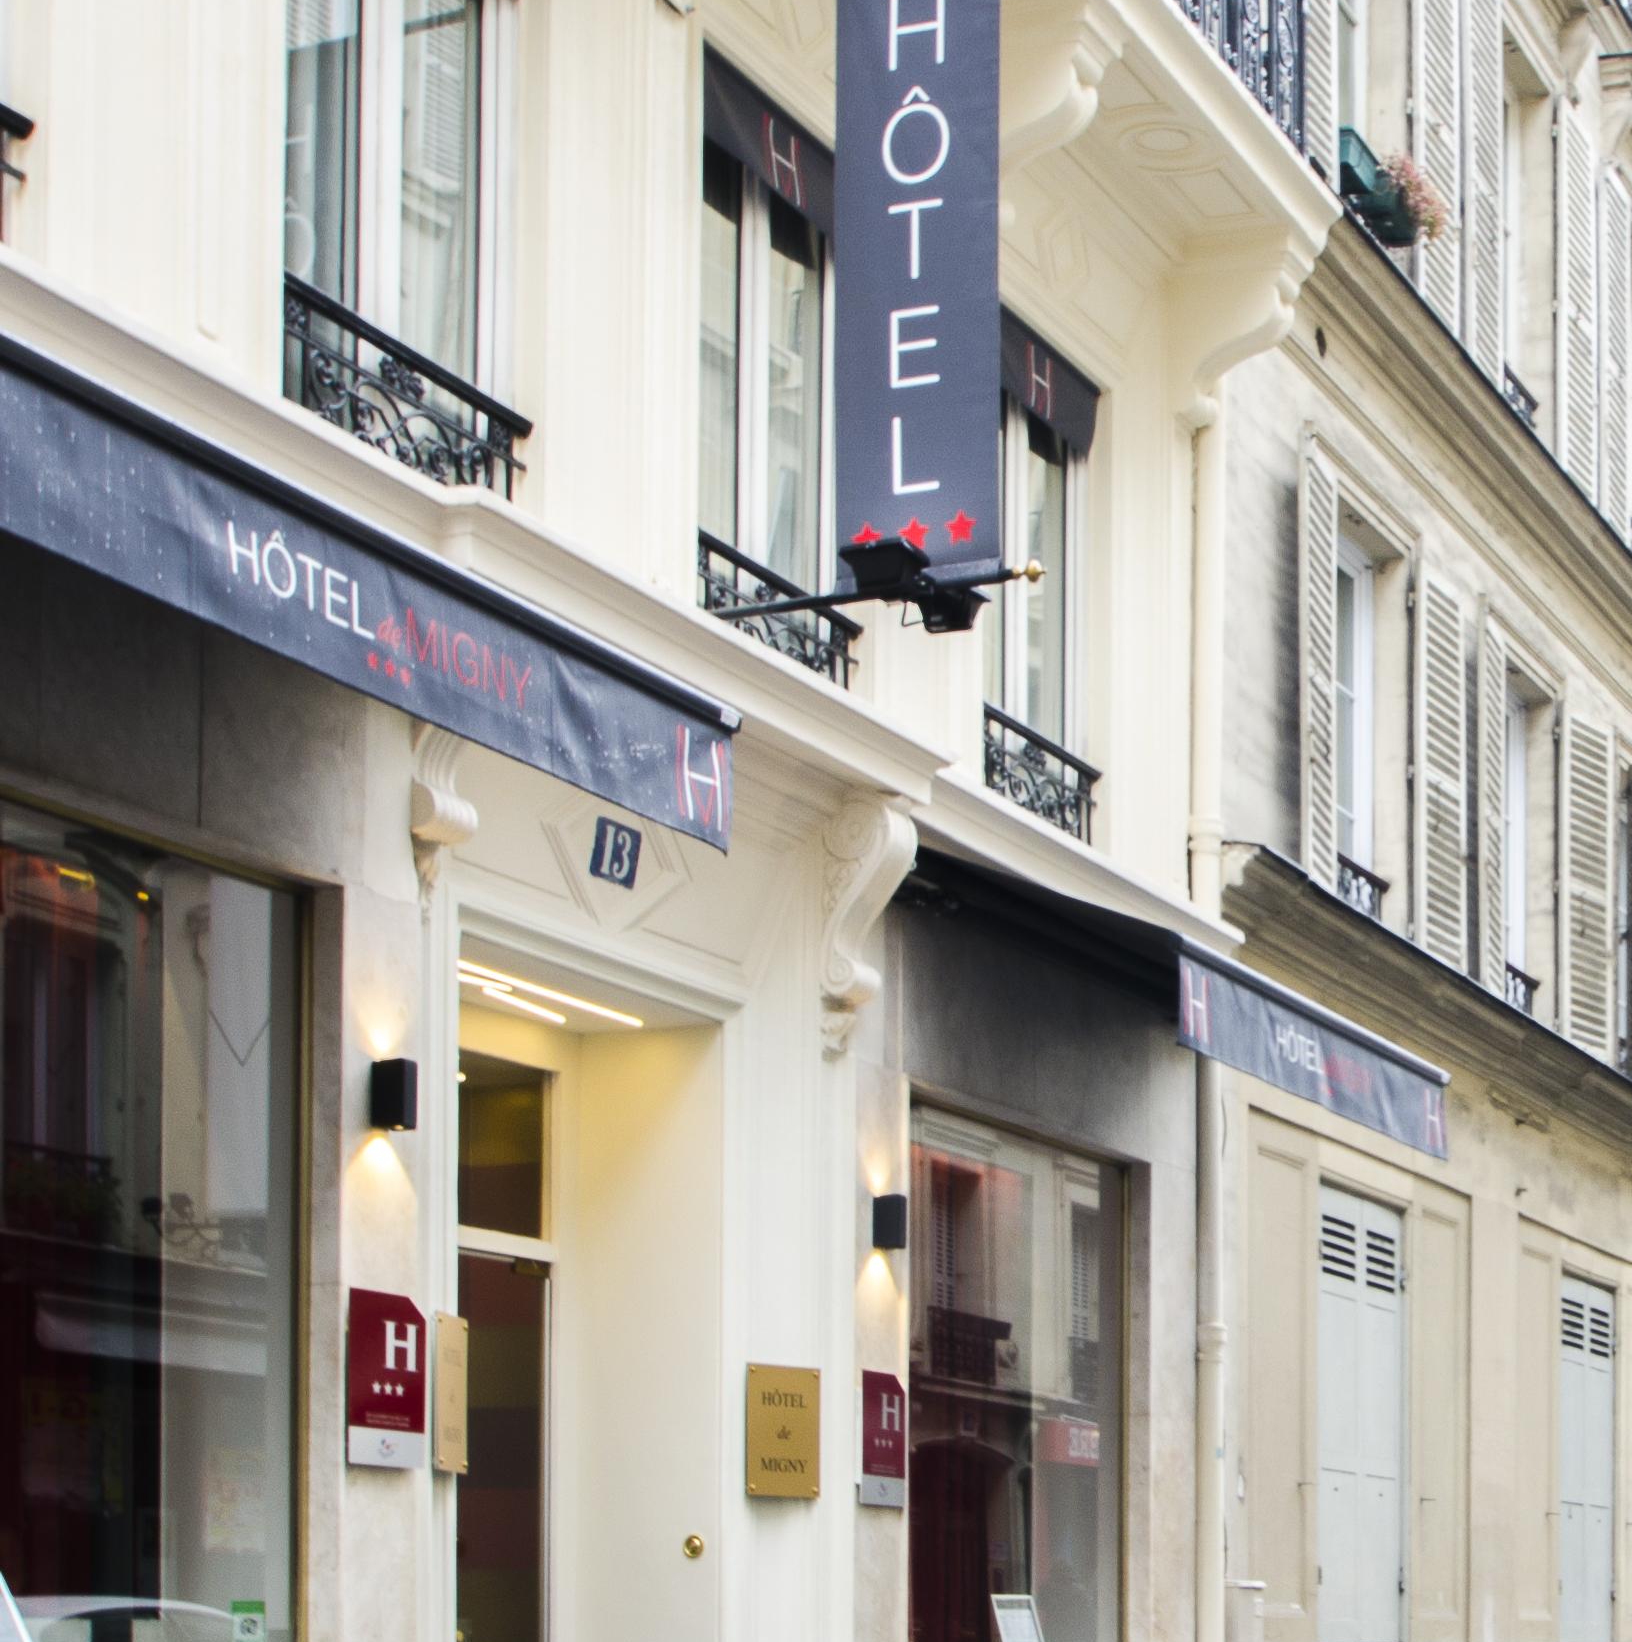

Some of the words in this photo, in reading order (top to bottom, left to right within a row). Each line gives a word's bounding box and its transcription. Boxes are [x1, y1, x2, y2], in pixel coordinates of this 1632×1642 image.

[226, 519, 377, 642] HÔTEL
[404, 606, 533, 710] MIGNY
[600, 825, 632, 880] 13
[1276, 1023, 1325, 1075] HÔTEL
[382, 1319, 419, 1373] H
[761, 1389, 808, 1409] HÔTEL
[881, 1393, 901, 1432] H
[776, 1425, 792, 1440] de
[761, 1457, 808, 1474] MIGNY
